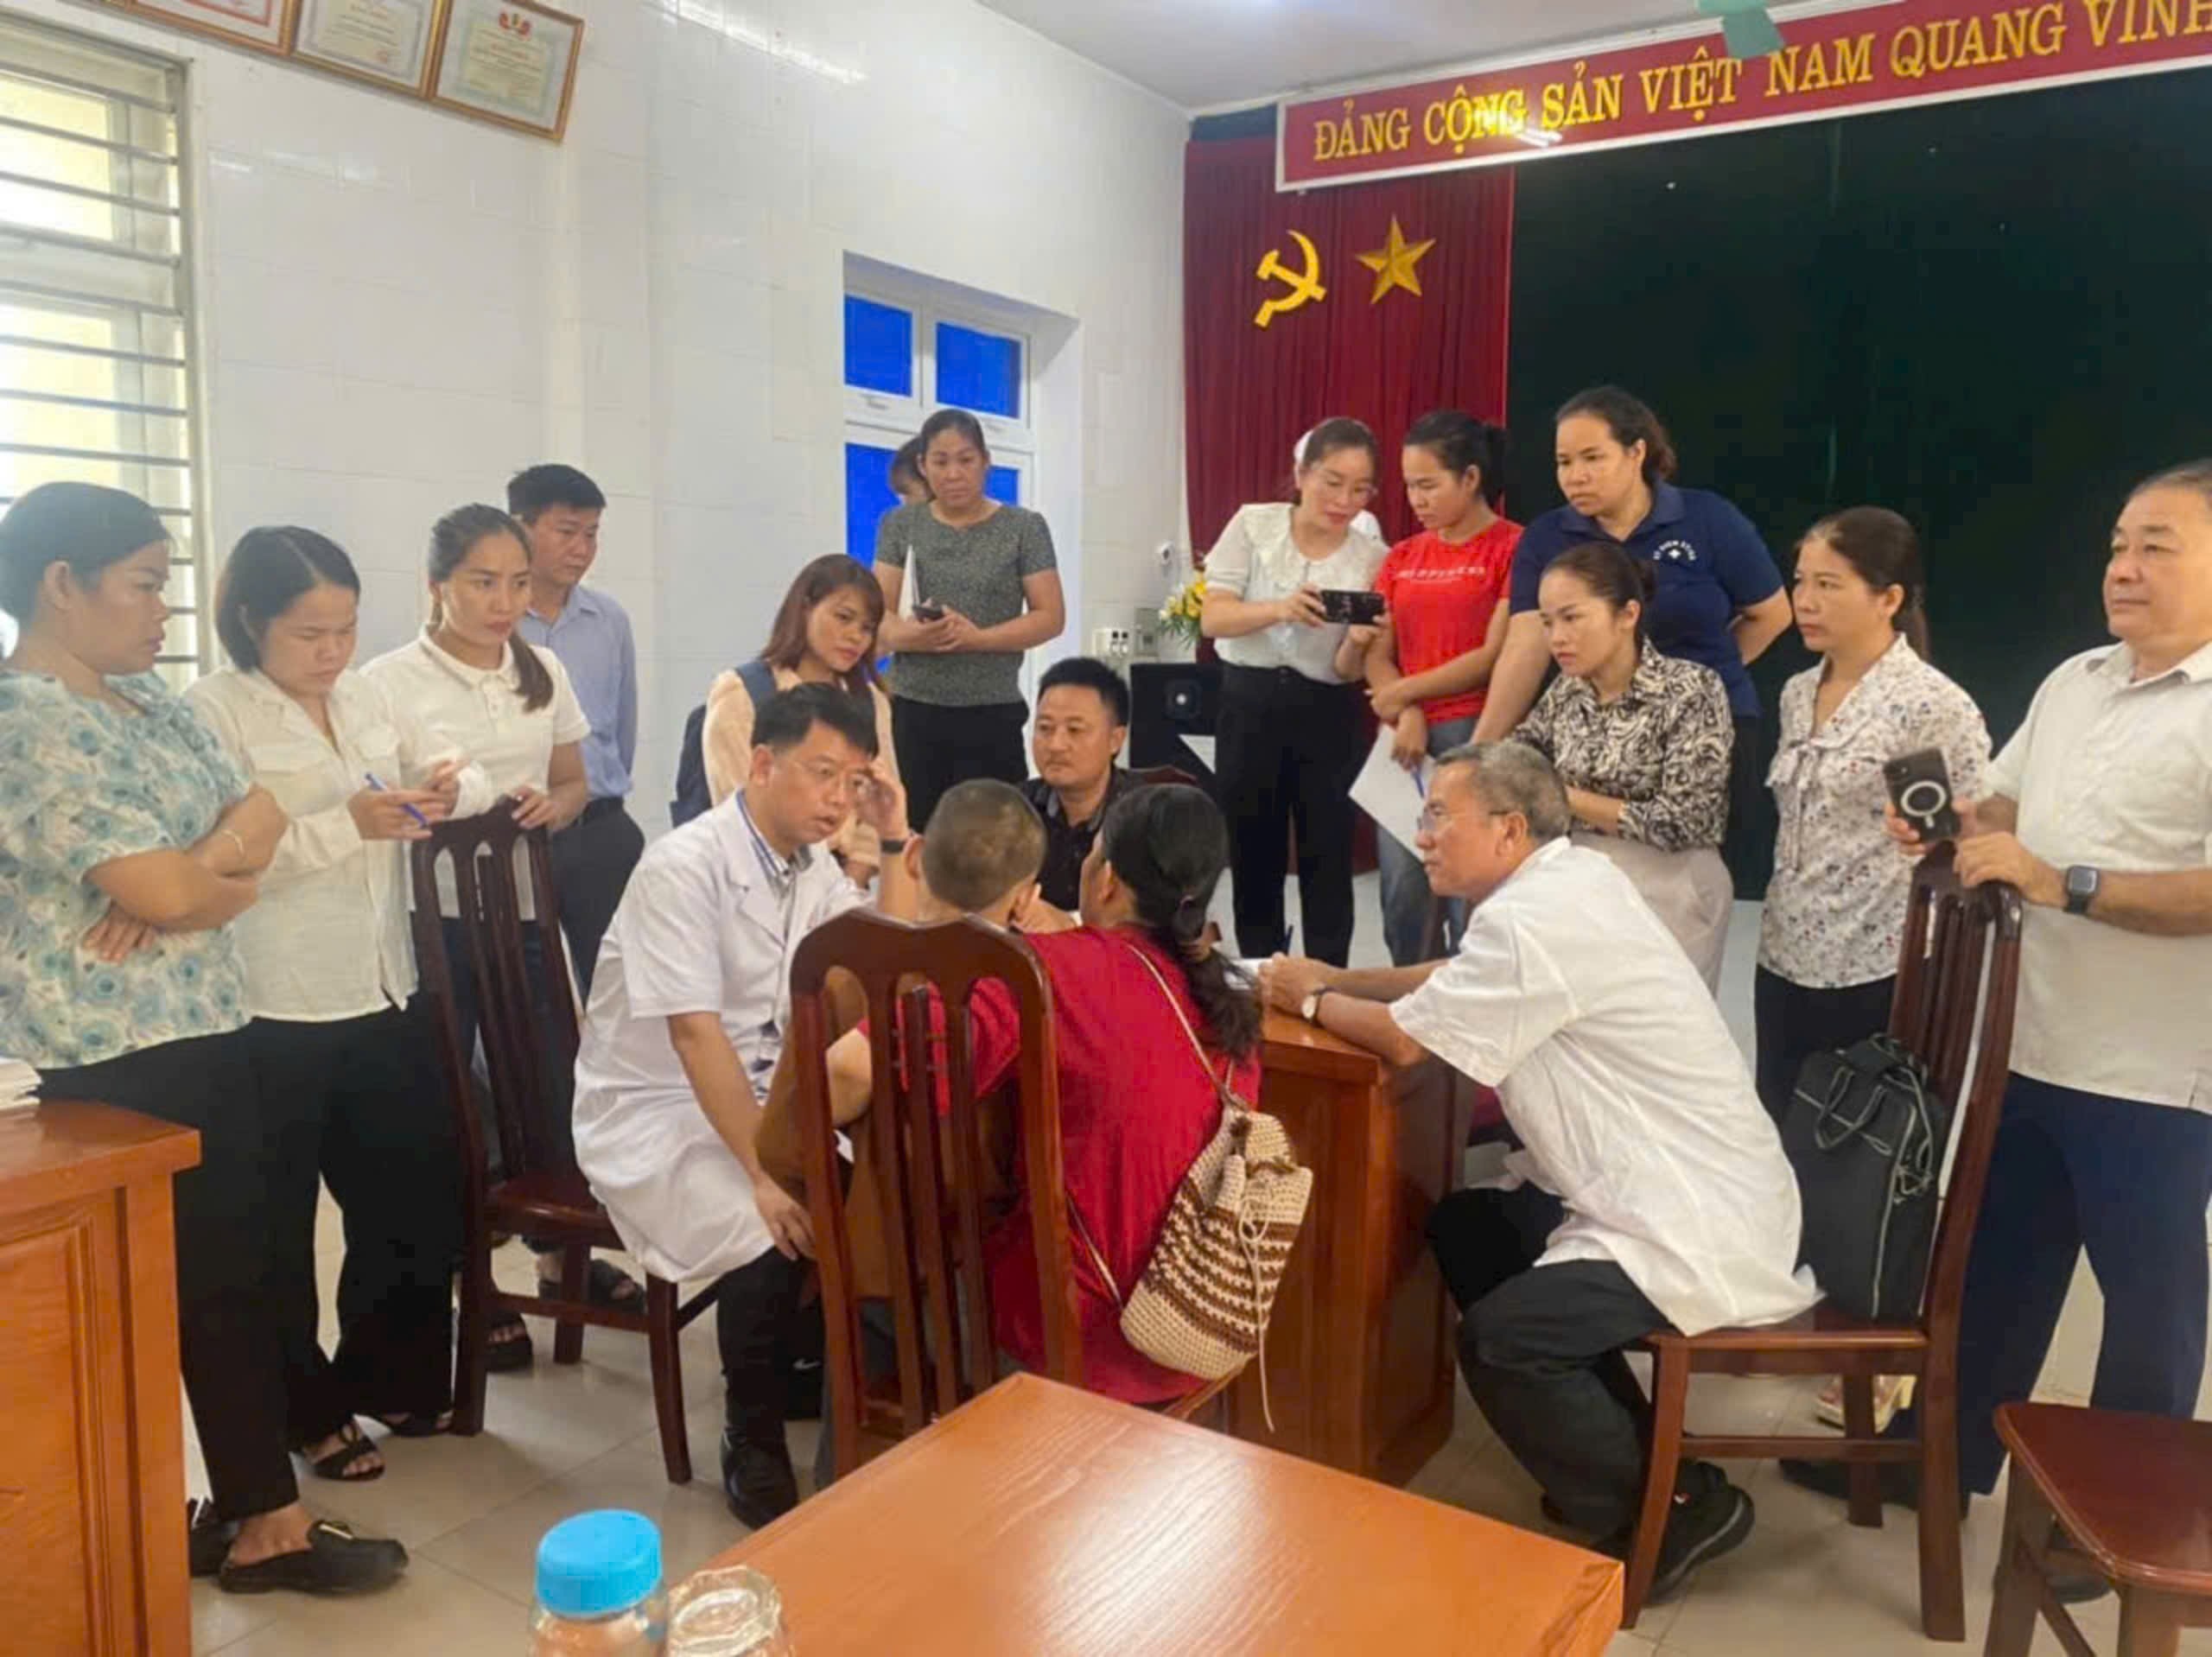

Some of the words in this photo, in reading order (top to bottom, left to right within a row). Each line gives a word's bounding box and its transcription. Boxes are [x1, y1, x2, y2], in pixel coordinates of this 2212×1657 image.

[1313, 98, 1411, 162] ĐẢNG
[1424, 84, 1528, 156] CỘNG
[1541, 60, 1624, 130] SẢN
[1639, 45, 1743, 122] VIỆT
[1764, 33, 1876, 97] NAM
[1889, 2, 2069, 79] QUANG
[2082, 0, 2212, 47] VINH
